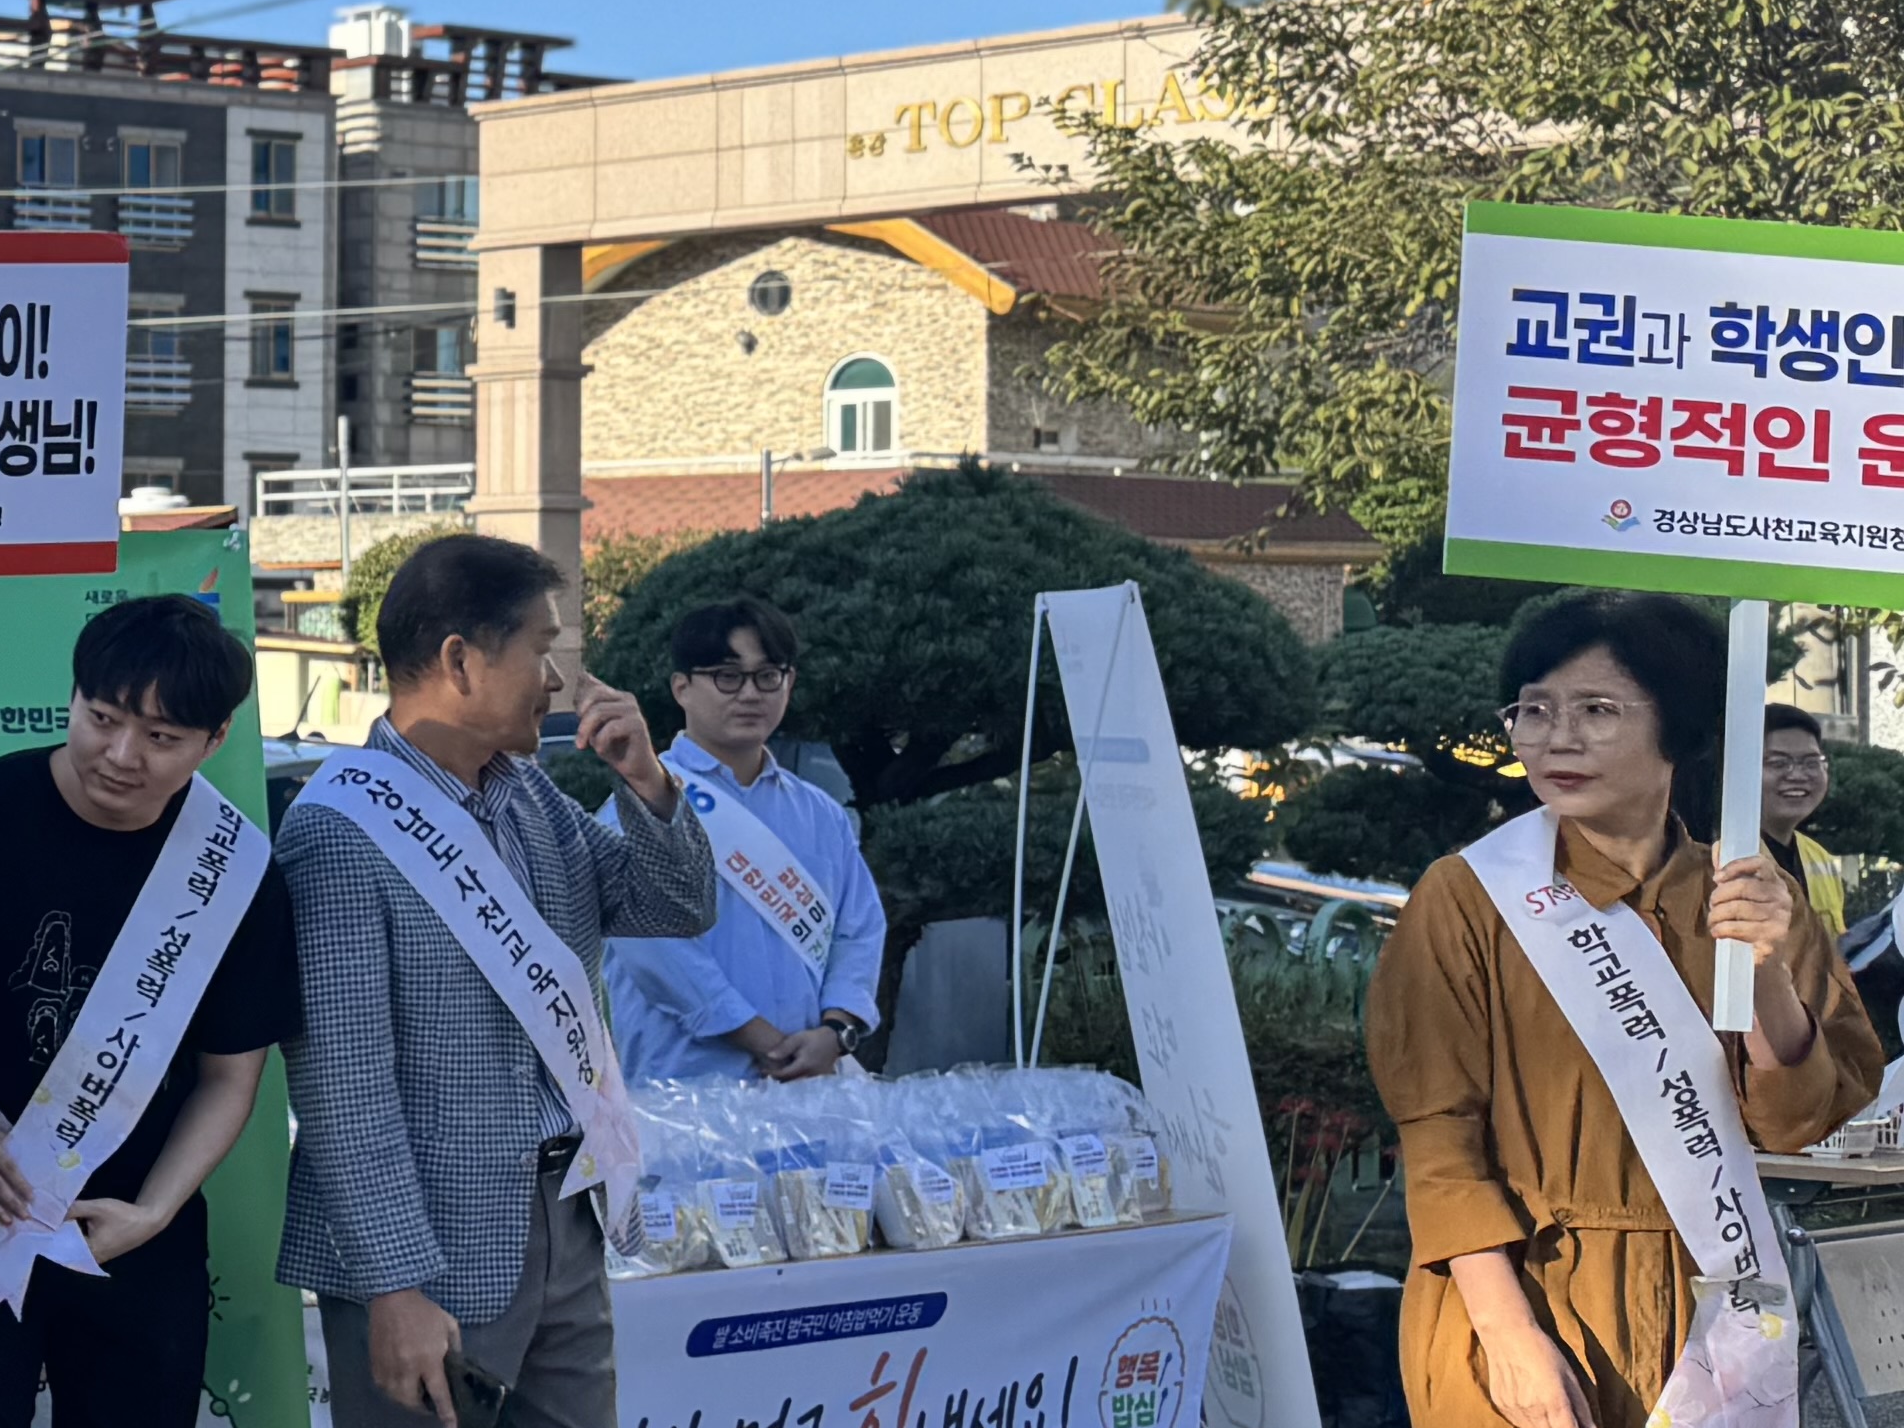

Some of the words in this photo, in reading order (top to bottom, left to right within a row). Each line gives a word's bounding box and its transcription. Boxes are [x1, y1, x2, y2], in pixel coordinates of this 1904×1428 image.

[894, 91, 1031, 154] TOP
[1505, 287, 1691, 370] 교권과
[1501, 385, 1831, 483] 균형적인
[186, 801, 245, 908] 학교폭력
[135, 923, 192, 1009] 성폭력
[1565, 921, 1668, 1041] 학교폭력
[1659, 1069, 1724, 1159] 성폭력
[54, 1033, 143, 1151] 사이버폭력
[1114, 1349, 1163, 1389] 행복
